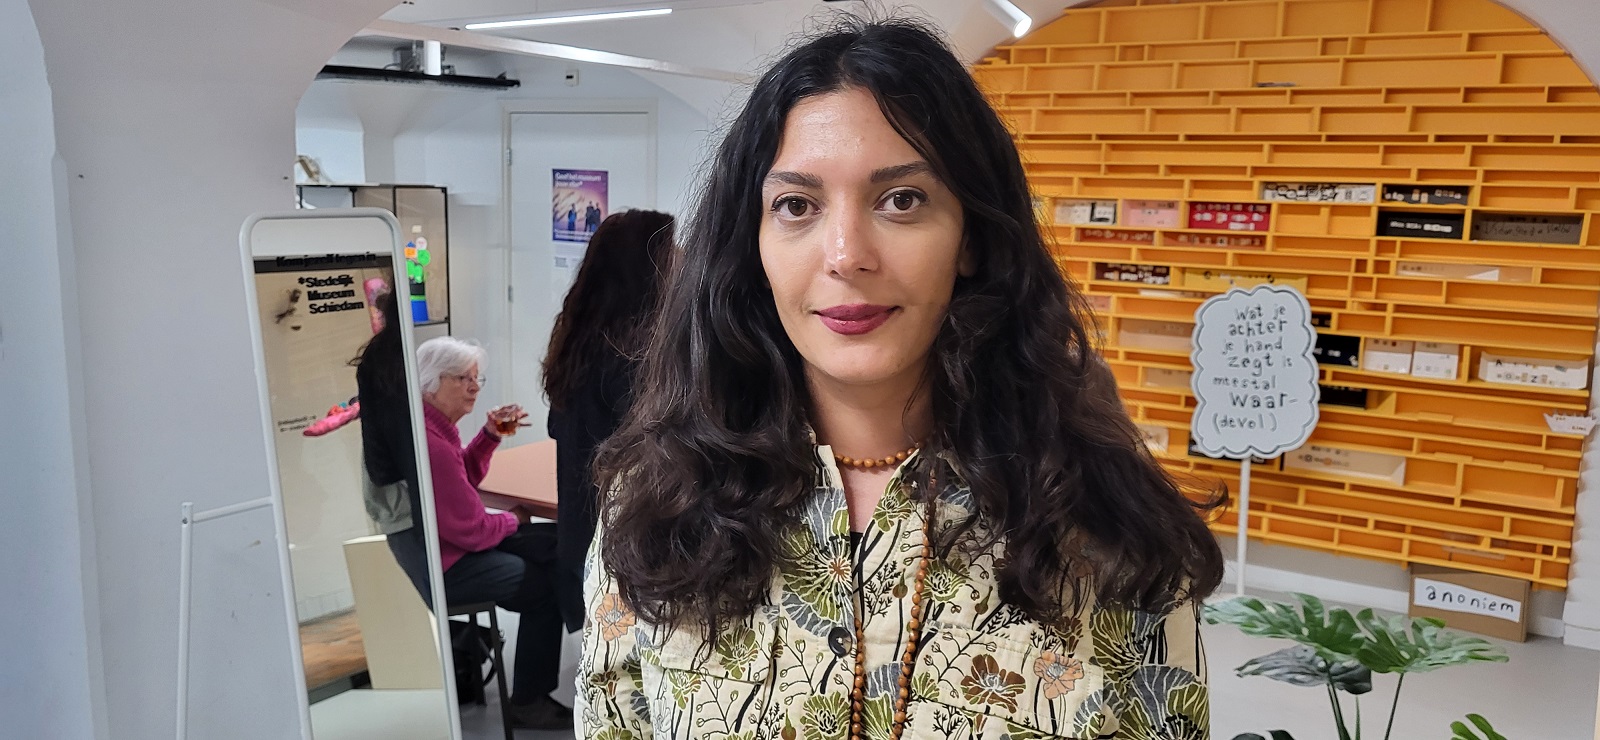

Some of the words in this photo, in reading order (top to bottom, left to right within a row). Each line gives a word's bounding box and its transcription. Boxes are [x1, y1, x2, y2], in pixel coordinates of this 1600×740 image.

[366, 251, 376, 261] in
[307, 290, 355, 301] Museum
[309, 301, 364, 314] Schiedam
[1273, 303, 1286, 320] je
[1228, 320, 1287, 336] achter
[1222, 339, 1234, 355] je
[1244, 336, 1283, 353] hand
[1228, 353, 1273, 377] zegt
[1282, 355, 1293, 367] is
[1212, 412, 1277, 435] (devol)
[1425, 585, 1514, 612] anoniem
